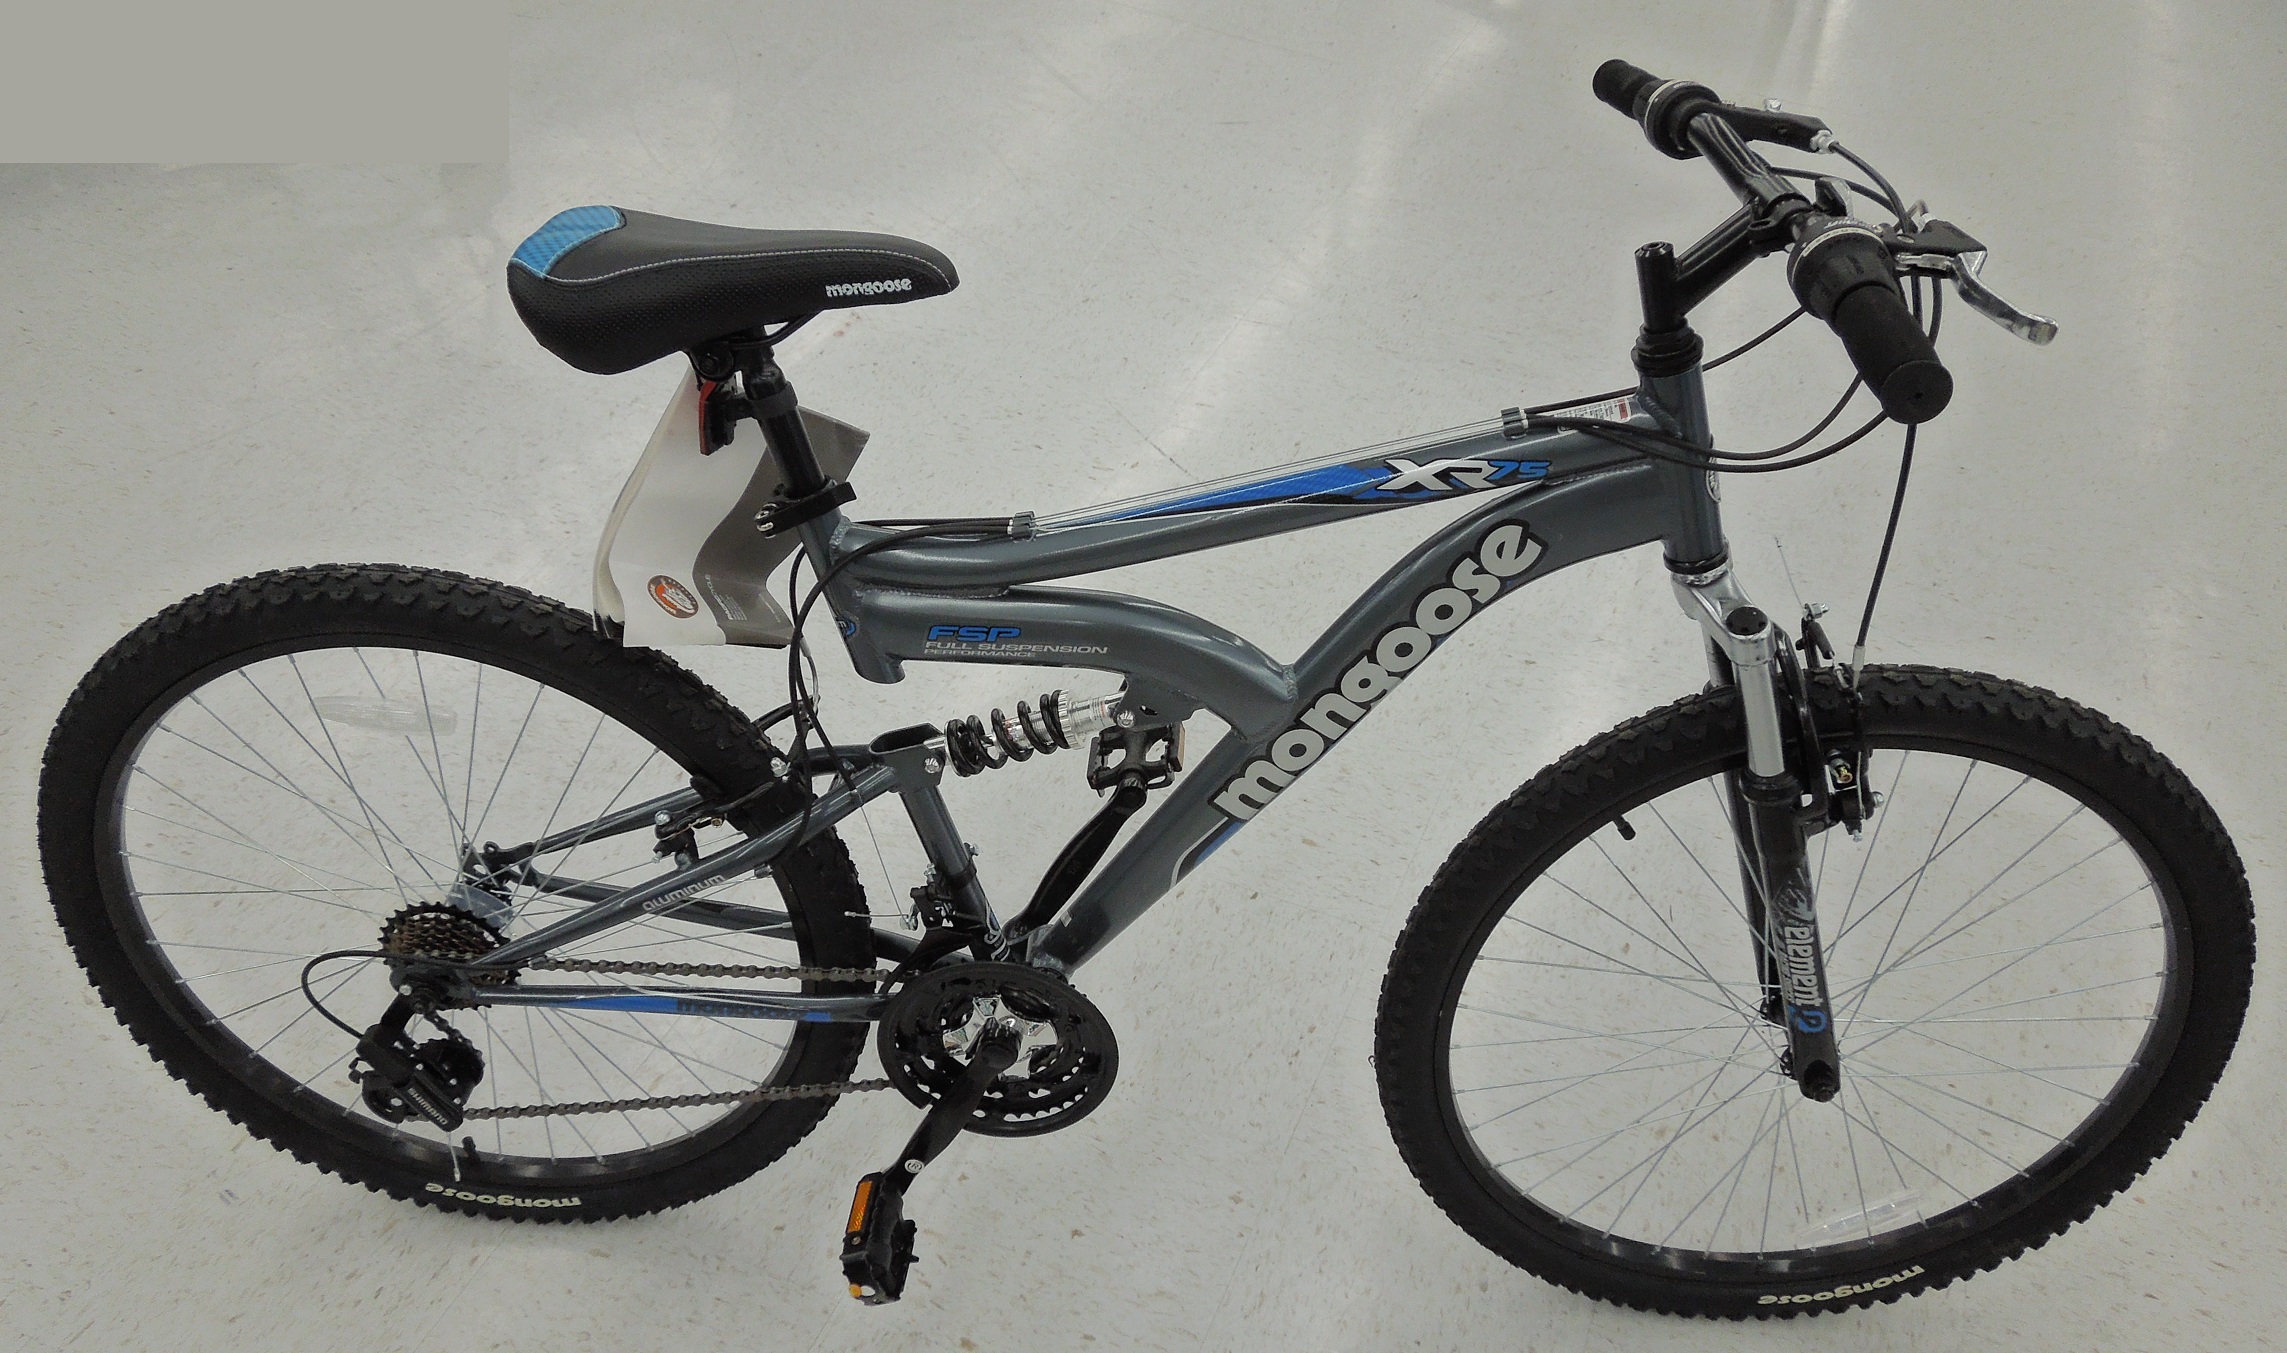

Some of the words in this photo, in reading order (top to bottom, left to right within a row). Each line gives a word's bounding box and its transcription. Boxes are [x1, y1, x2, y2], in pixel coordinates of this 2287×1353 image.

[826, 278, 912, 297] mongoose
[927, 625, 1021, 642] FSP
[924, 649, 1037, 658] PERFORMANCE
[925, 641, 972, 650] FULL
[978, 643, 1108, 654] SUSPENSION
[1214, 524, 1543, 820] mongoose
[642, 875, 726, 911] aluminum
[1784, 926, 1824, 1007] element
[425, 1182, 582, 1208] mongoose
[1757, 1265, 1925, 1305] mongoose
